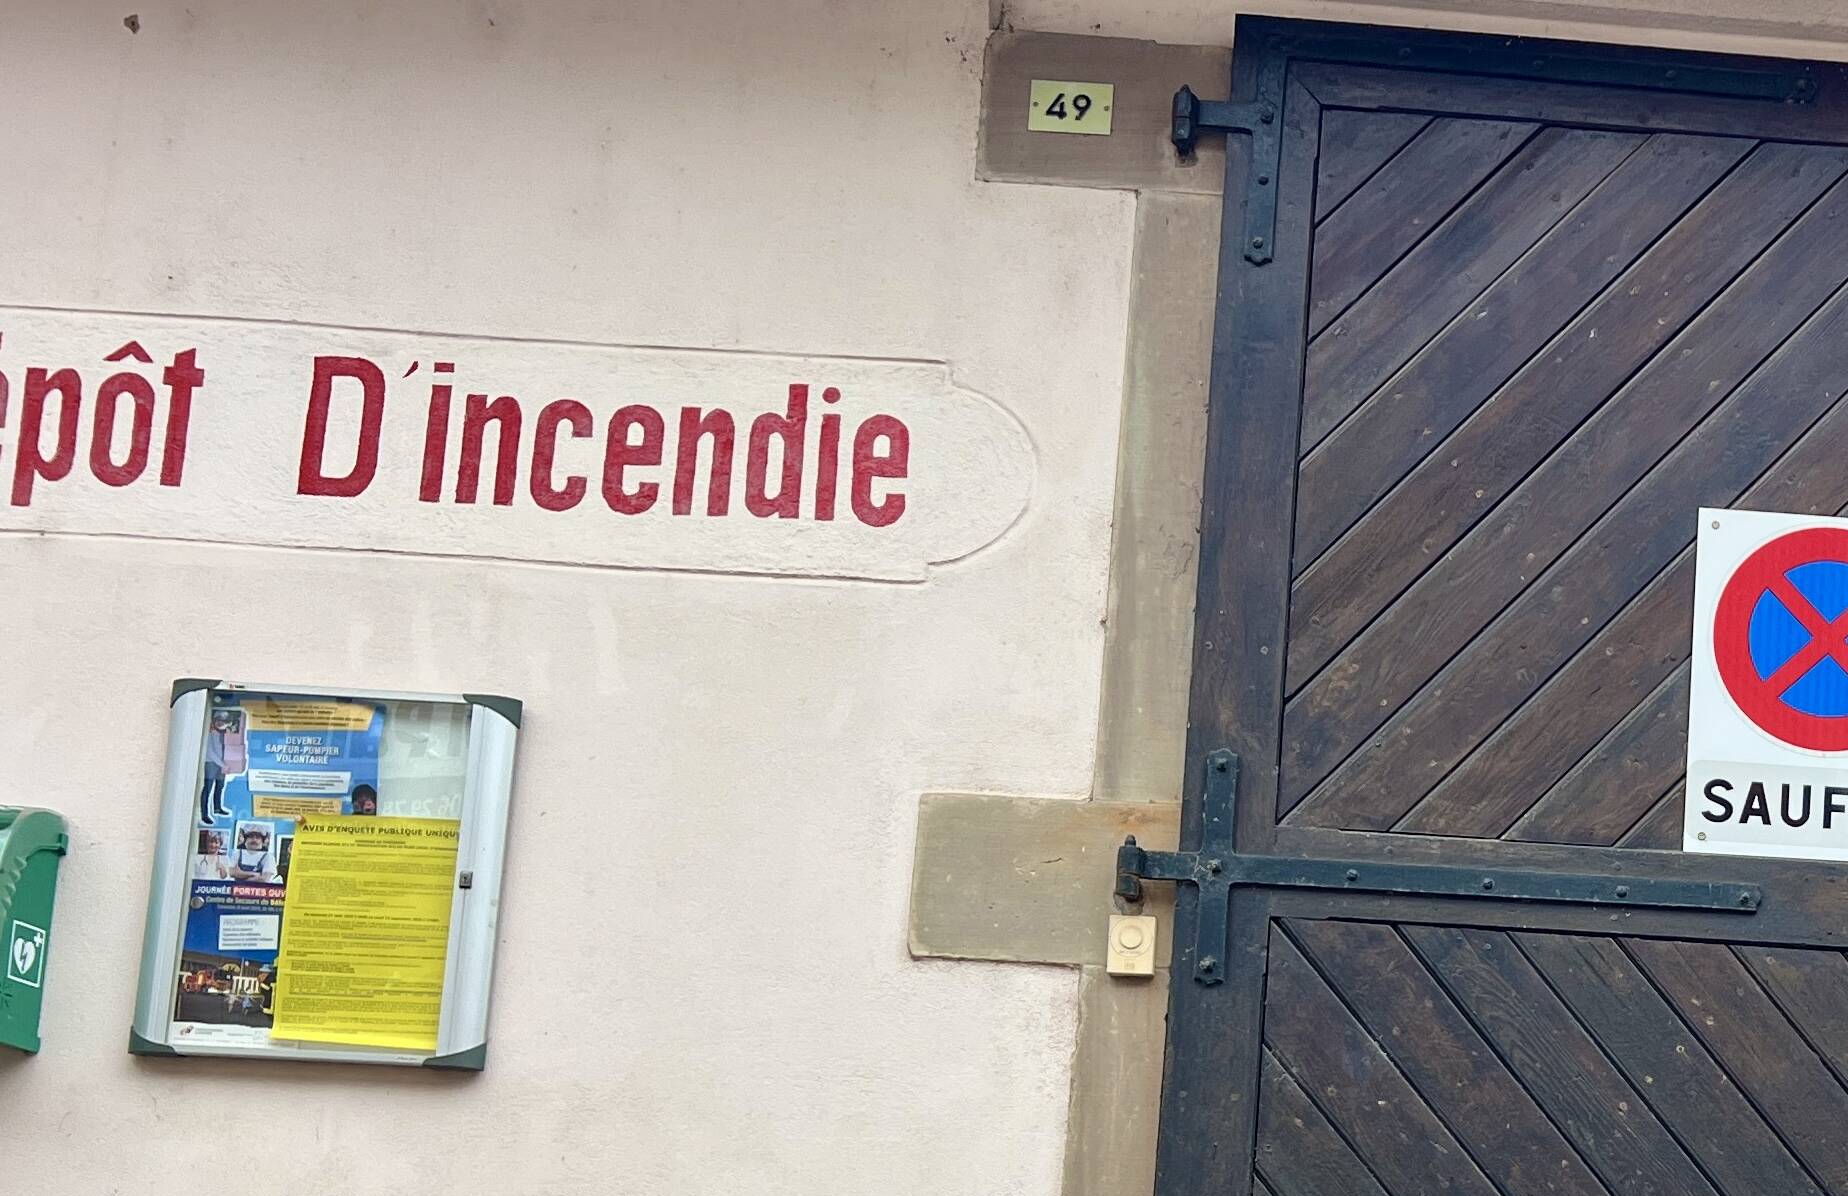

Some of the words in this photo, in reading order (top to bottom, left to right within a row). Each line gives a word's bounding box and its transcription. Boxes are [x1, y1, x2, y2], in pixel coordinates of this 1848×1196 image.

[1045, 93, 1092, 122] 49
[0, 331, 205, 507] pôt
[297, 355, 911, 528] D'incendie
[285, 735, 323, 746] DEVENEZ
[264, 743, 340, 757] SAPEUR-POMPIER
[275, 753, 330, 765] VOLONTAIRE
[302, 824, 326, 833] AVIS
[378, 827, 424, 838] PUBLIQUE
[195, 884, 232, 895] JOURNÉE
[232, 885, 268, 897] PORTES
